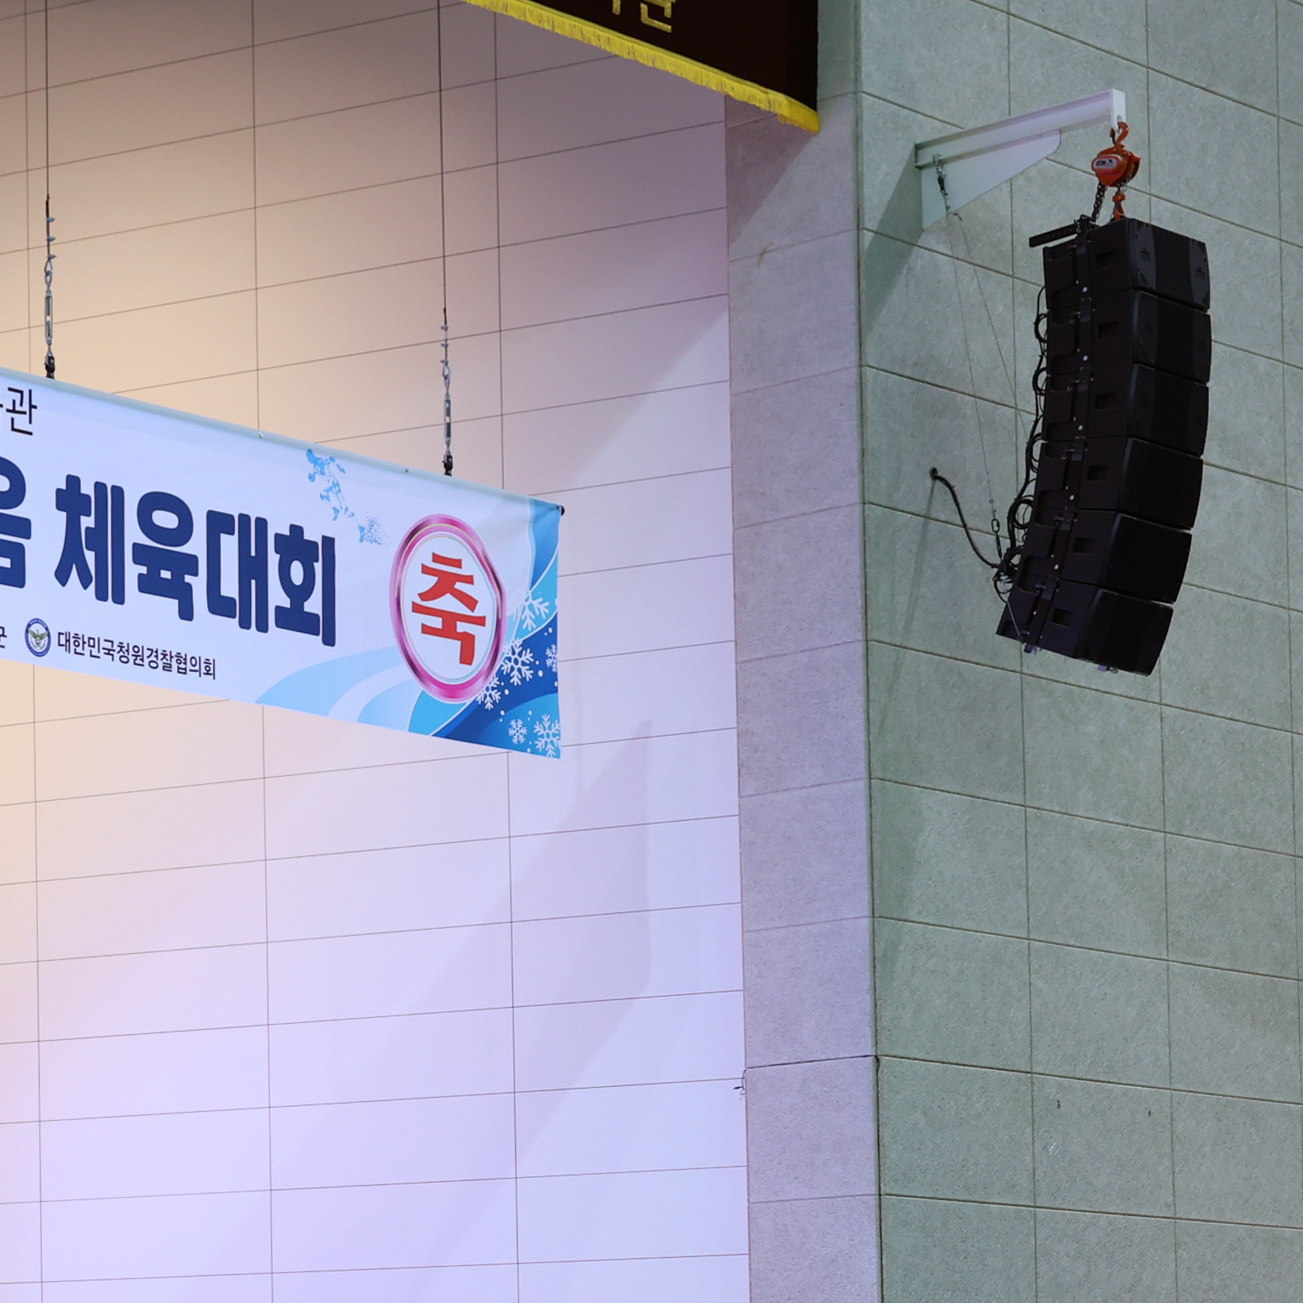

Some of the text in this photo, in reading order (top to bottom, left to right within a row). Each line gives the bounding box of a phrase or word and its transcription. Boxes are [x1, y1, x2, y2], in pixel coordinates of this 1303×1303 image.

[53, 473, 338, 647] 체육대회
[410, 551, 487, 668] 축
[57, 631, 217, 681] 대한민국청원경찰협의회
